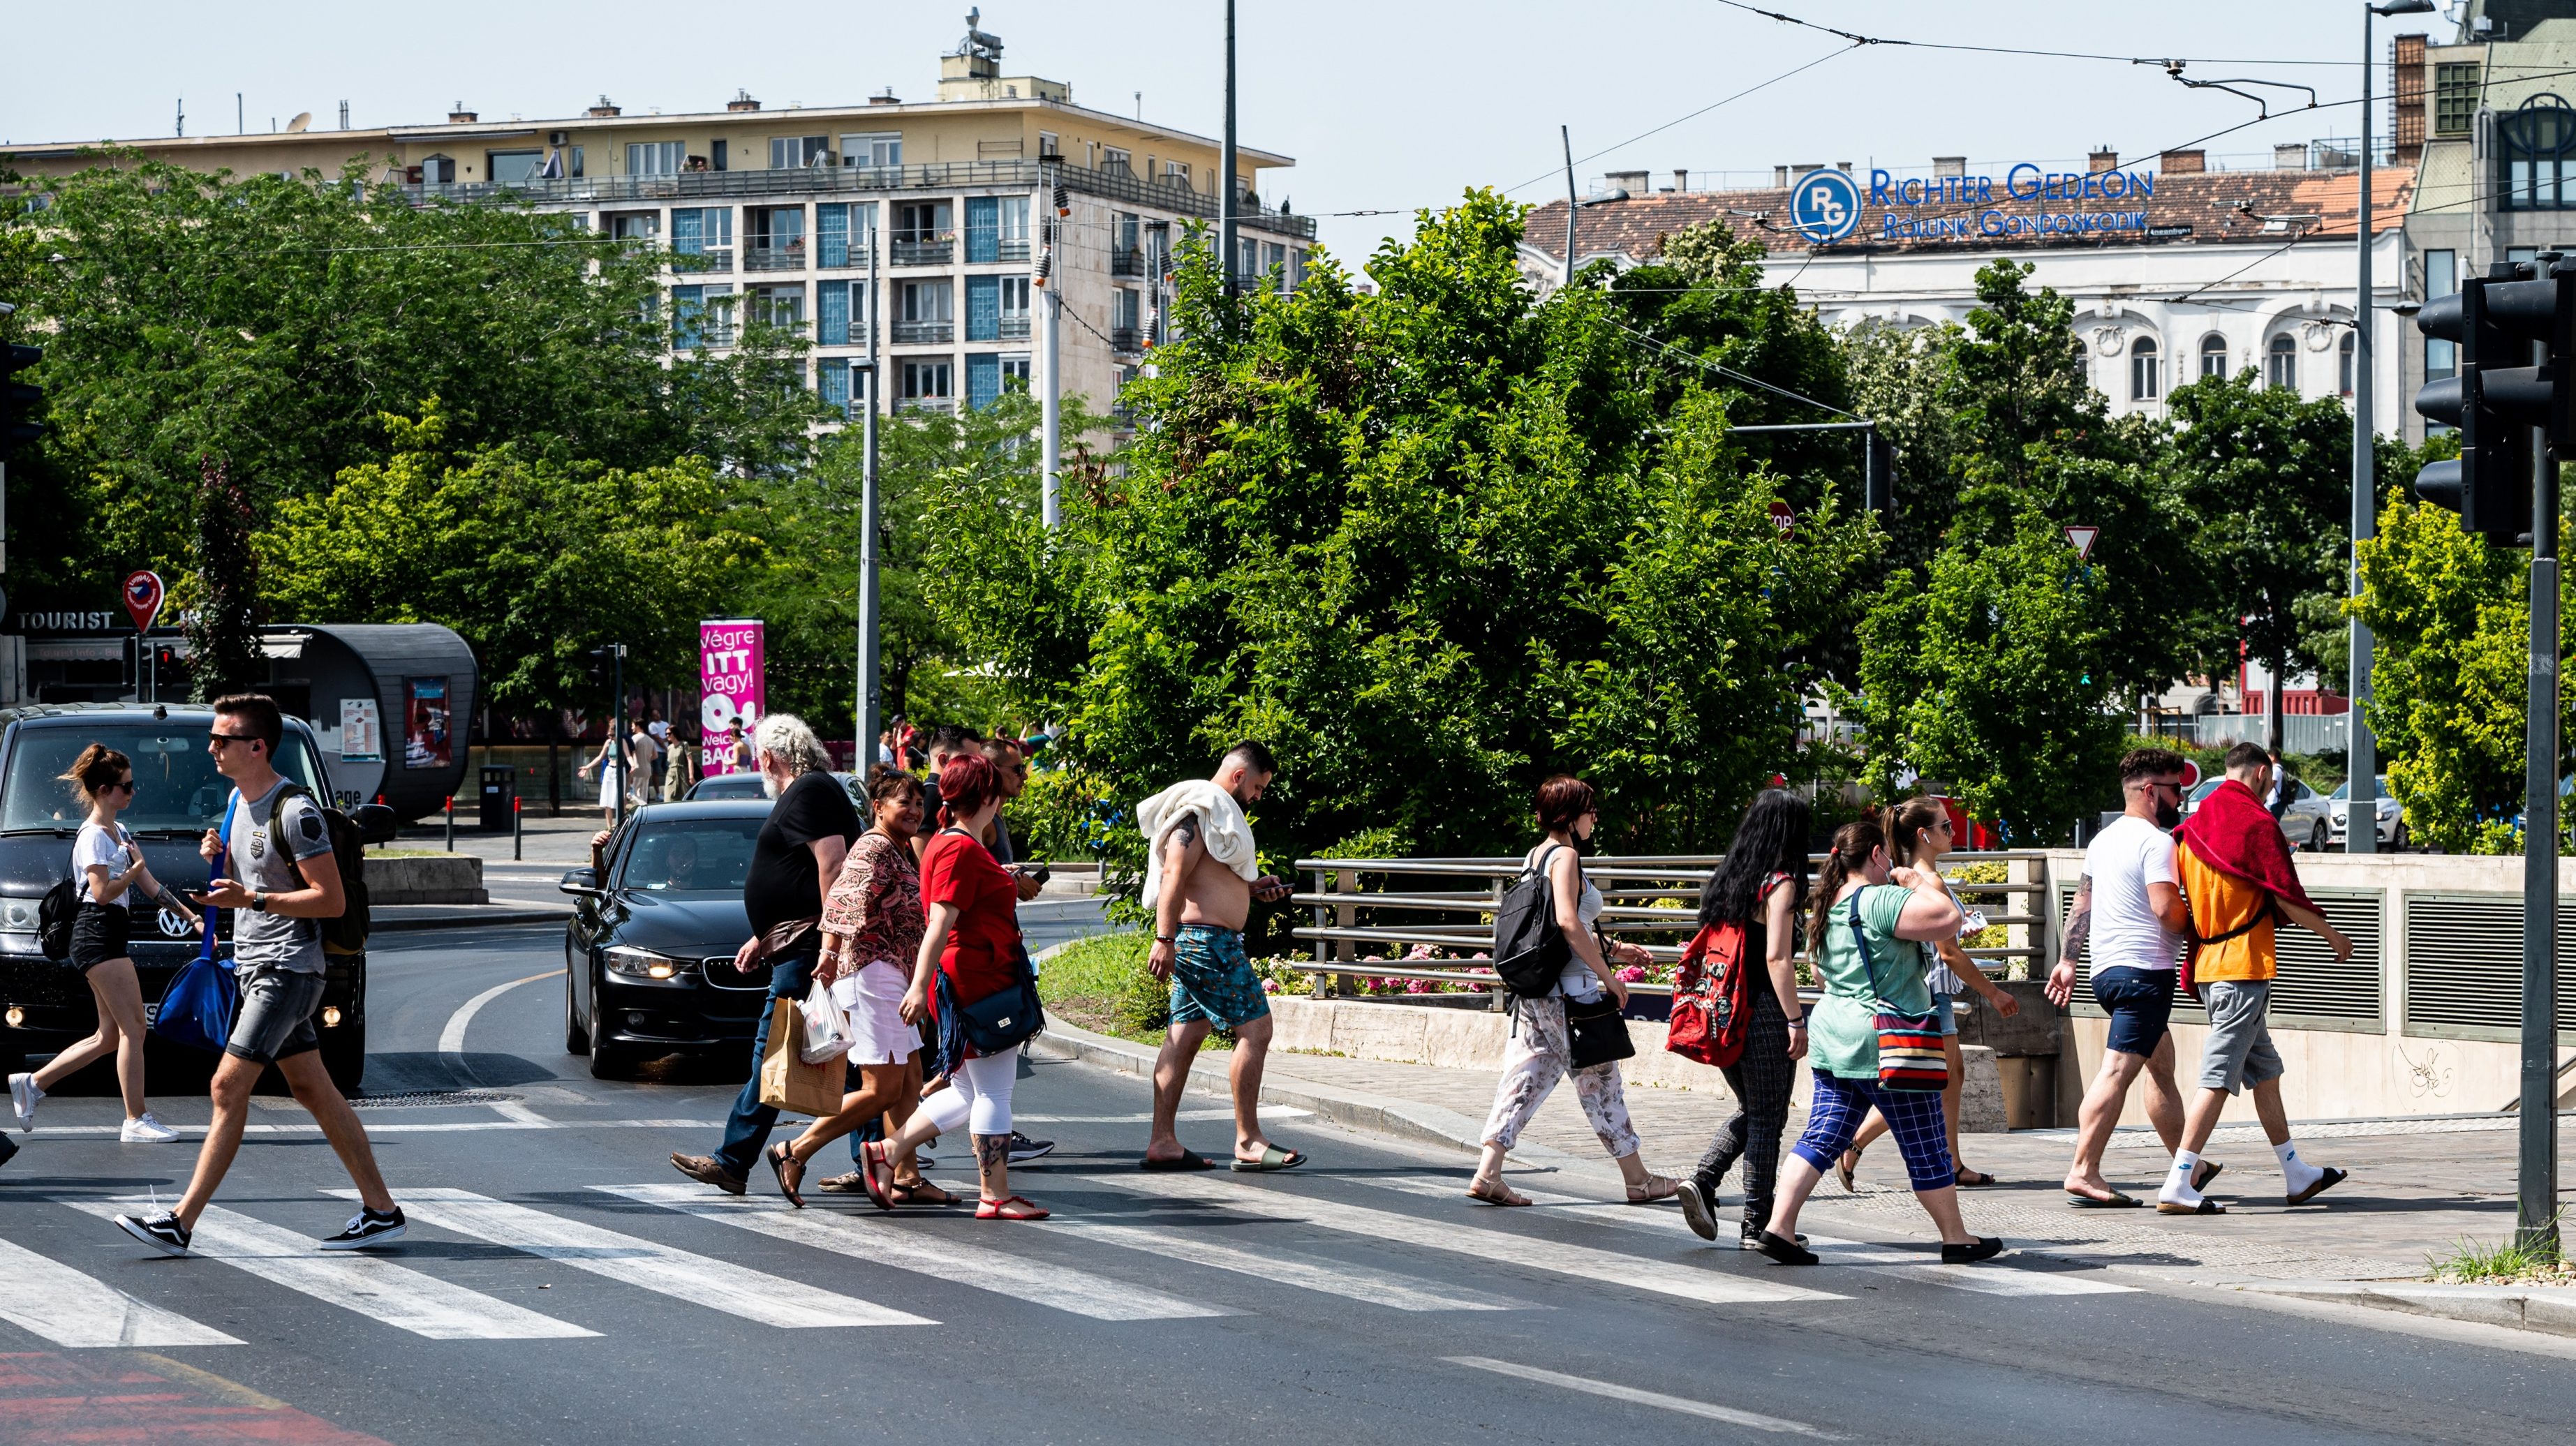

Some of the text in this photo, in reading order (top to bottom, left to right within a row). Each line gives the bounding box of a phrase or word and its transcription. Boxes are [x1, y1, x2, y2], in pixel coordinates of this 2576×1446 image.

[1812, 186, 1846, 226] RG
[1772, 515, 1792, 530] OP
[17, 611, 114, 629] TOURIST
[700, 629, 755, 650] Végre
[706, 649, 750, 675] ITT
[702, 668, 754, 694] vagy!
